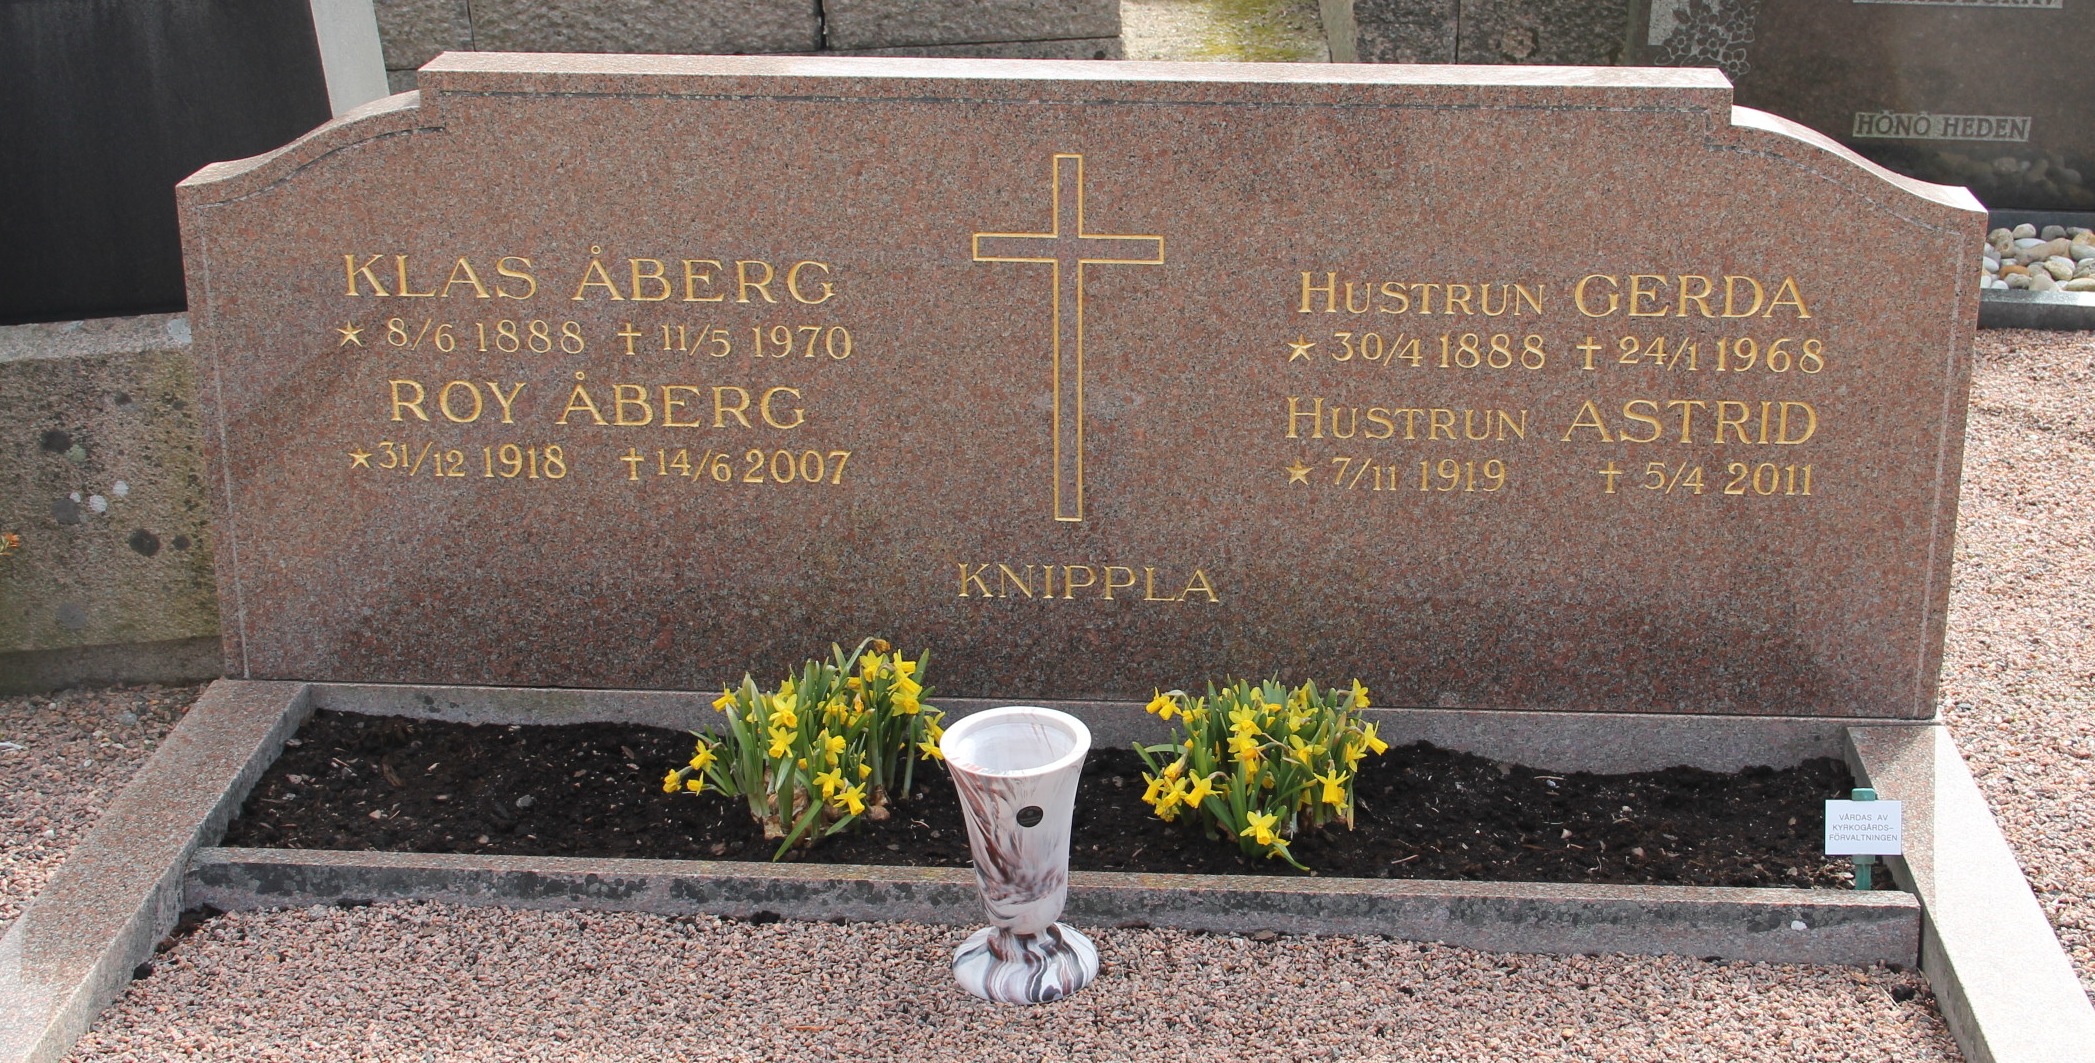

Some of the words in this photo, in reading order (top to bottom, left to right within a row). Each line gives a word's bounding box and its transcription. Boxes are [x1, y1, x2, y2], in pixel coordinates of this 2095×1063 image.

[1856, 109, 1931, 136] HÖNÖ
[1941, 116, 2028, 140] HEDEN
[344, 254, 537, 301] KLAS
[571, 245, 835, 305] ÅBERG
[1573, 273, 1811, 318] GERDA
[387, 317, 456, 352] 8/6
[476, 319, 585, 354] 1888
[660, 323, 732, 358] 11/5
[752, 326, 853, 360] 1970
[1332, 332, 1423, 368] 30/4
[1438, 333, 1546, 370] 1888
[1618, 336, 1698, 372] 24/1
[1717, 338, 1825, 374] 1968
[388, 379, 527, 424] ROY
[555, 371, 806, 429] ÅBERG
[1560, 400, 1818, 445] ASTRID
[378, 441, 466, 477] 31/12
[483, 445, 568, 479] 1918
[657, 448, 733, 483] 14/6
[743, 450, 852, 485] 2007
[1332, 457, 1397, 492] 7/11
[1419, 459, 1506, 493] 1919
[1644, 461, 1704, 494] 5/4
[1724, 462, 1812, 497] 2011
[958, 562, 1220, 603] KNIPPLA
[1829, 833, 1898, 842] FÖRVALTNINGEN
[1832, 823, 1893, 832] KYRKOGÅRDS-
[1839, 813, 1872, 821] VÅRDAS
